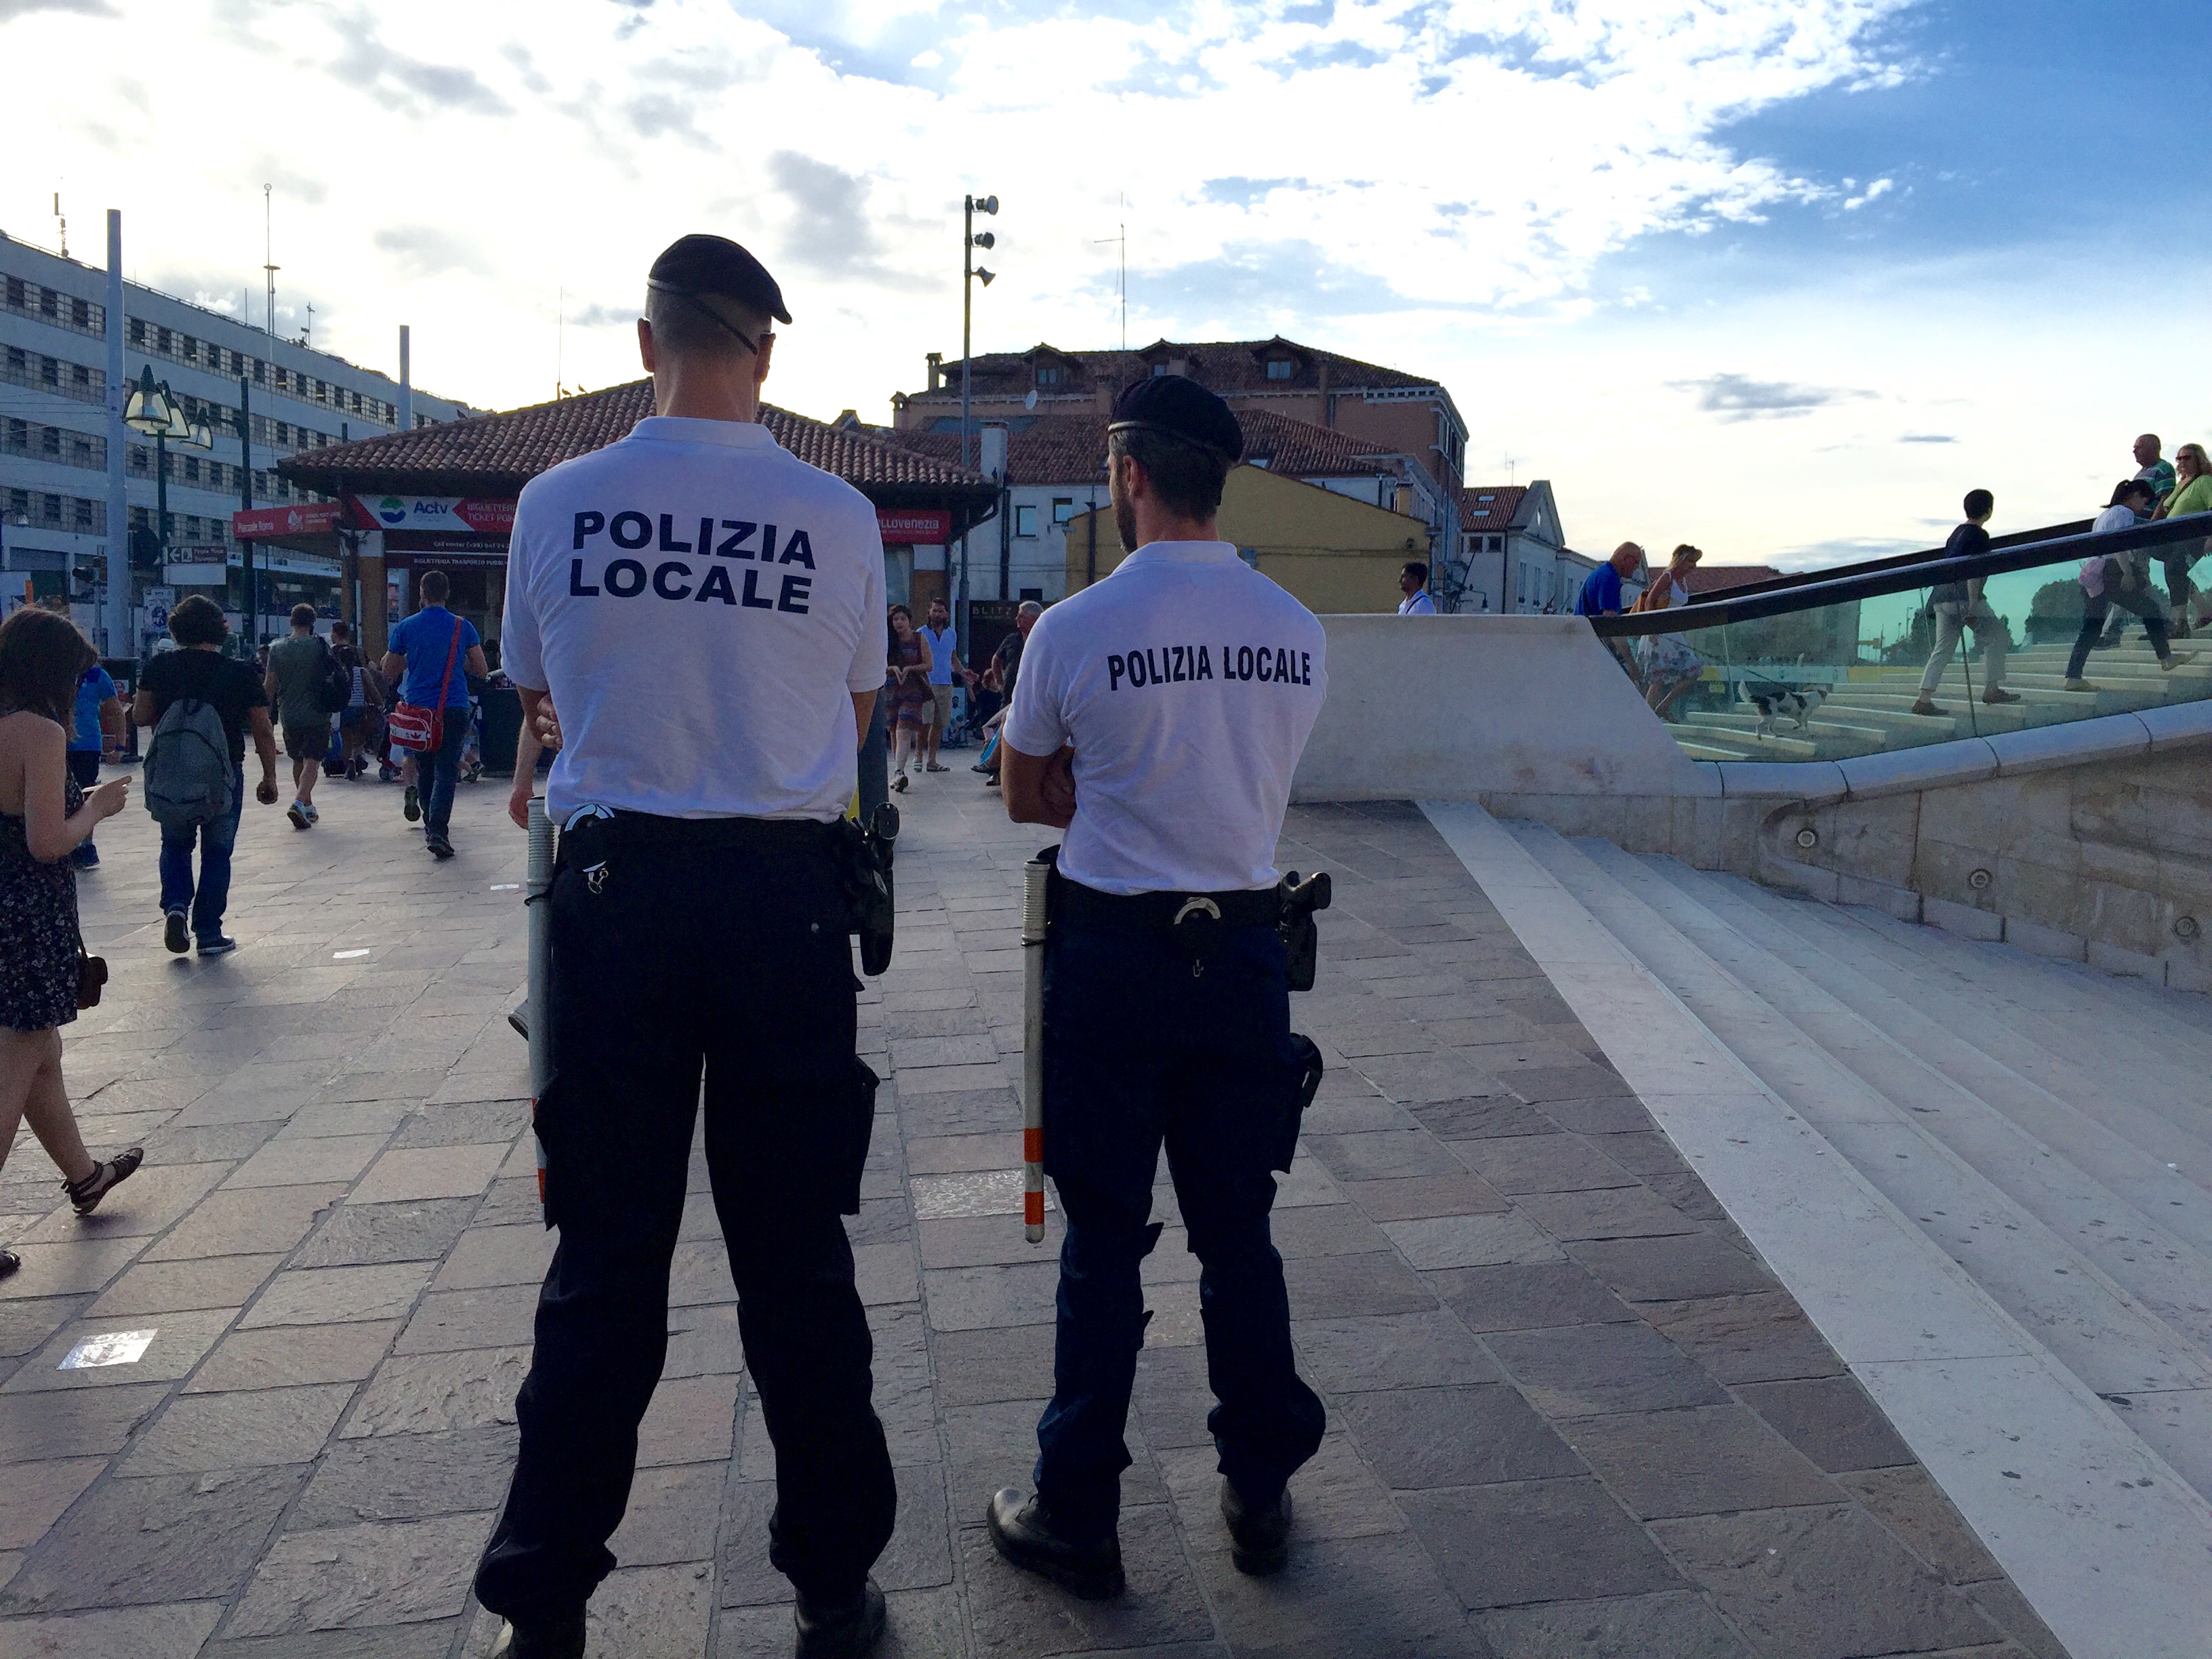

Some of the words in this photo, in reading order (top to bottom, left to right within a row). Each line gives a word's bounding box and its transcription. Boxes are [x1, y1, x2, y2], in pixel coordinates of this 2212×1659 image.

[413, 500, 448, 514] Actv
[573, 511, 816, 570] POLIZIA
[570, 559, 813, 614] LOCALE
[1107, 646, 1213, 691] POLIZIA
[1223, 646, 1311, 686] LOCALE
